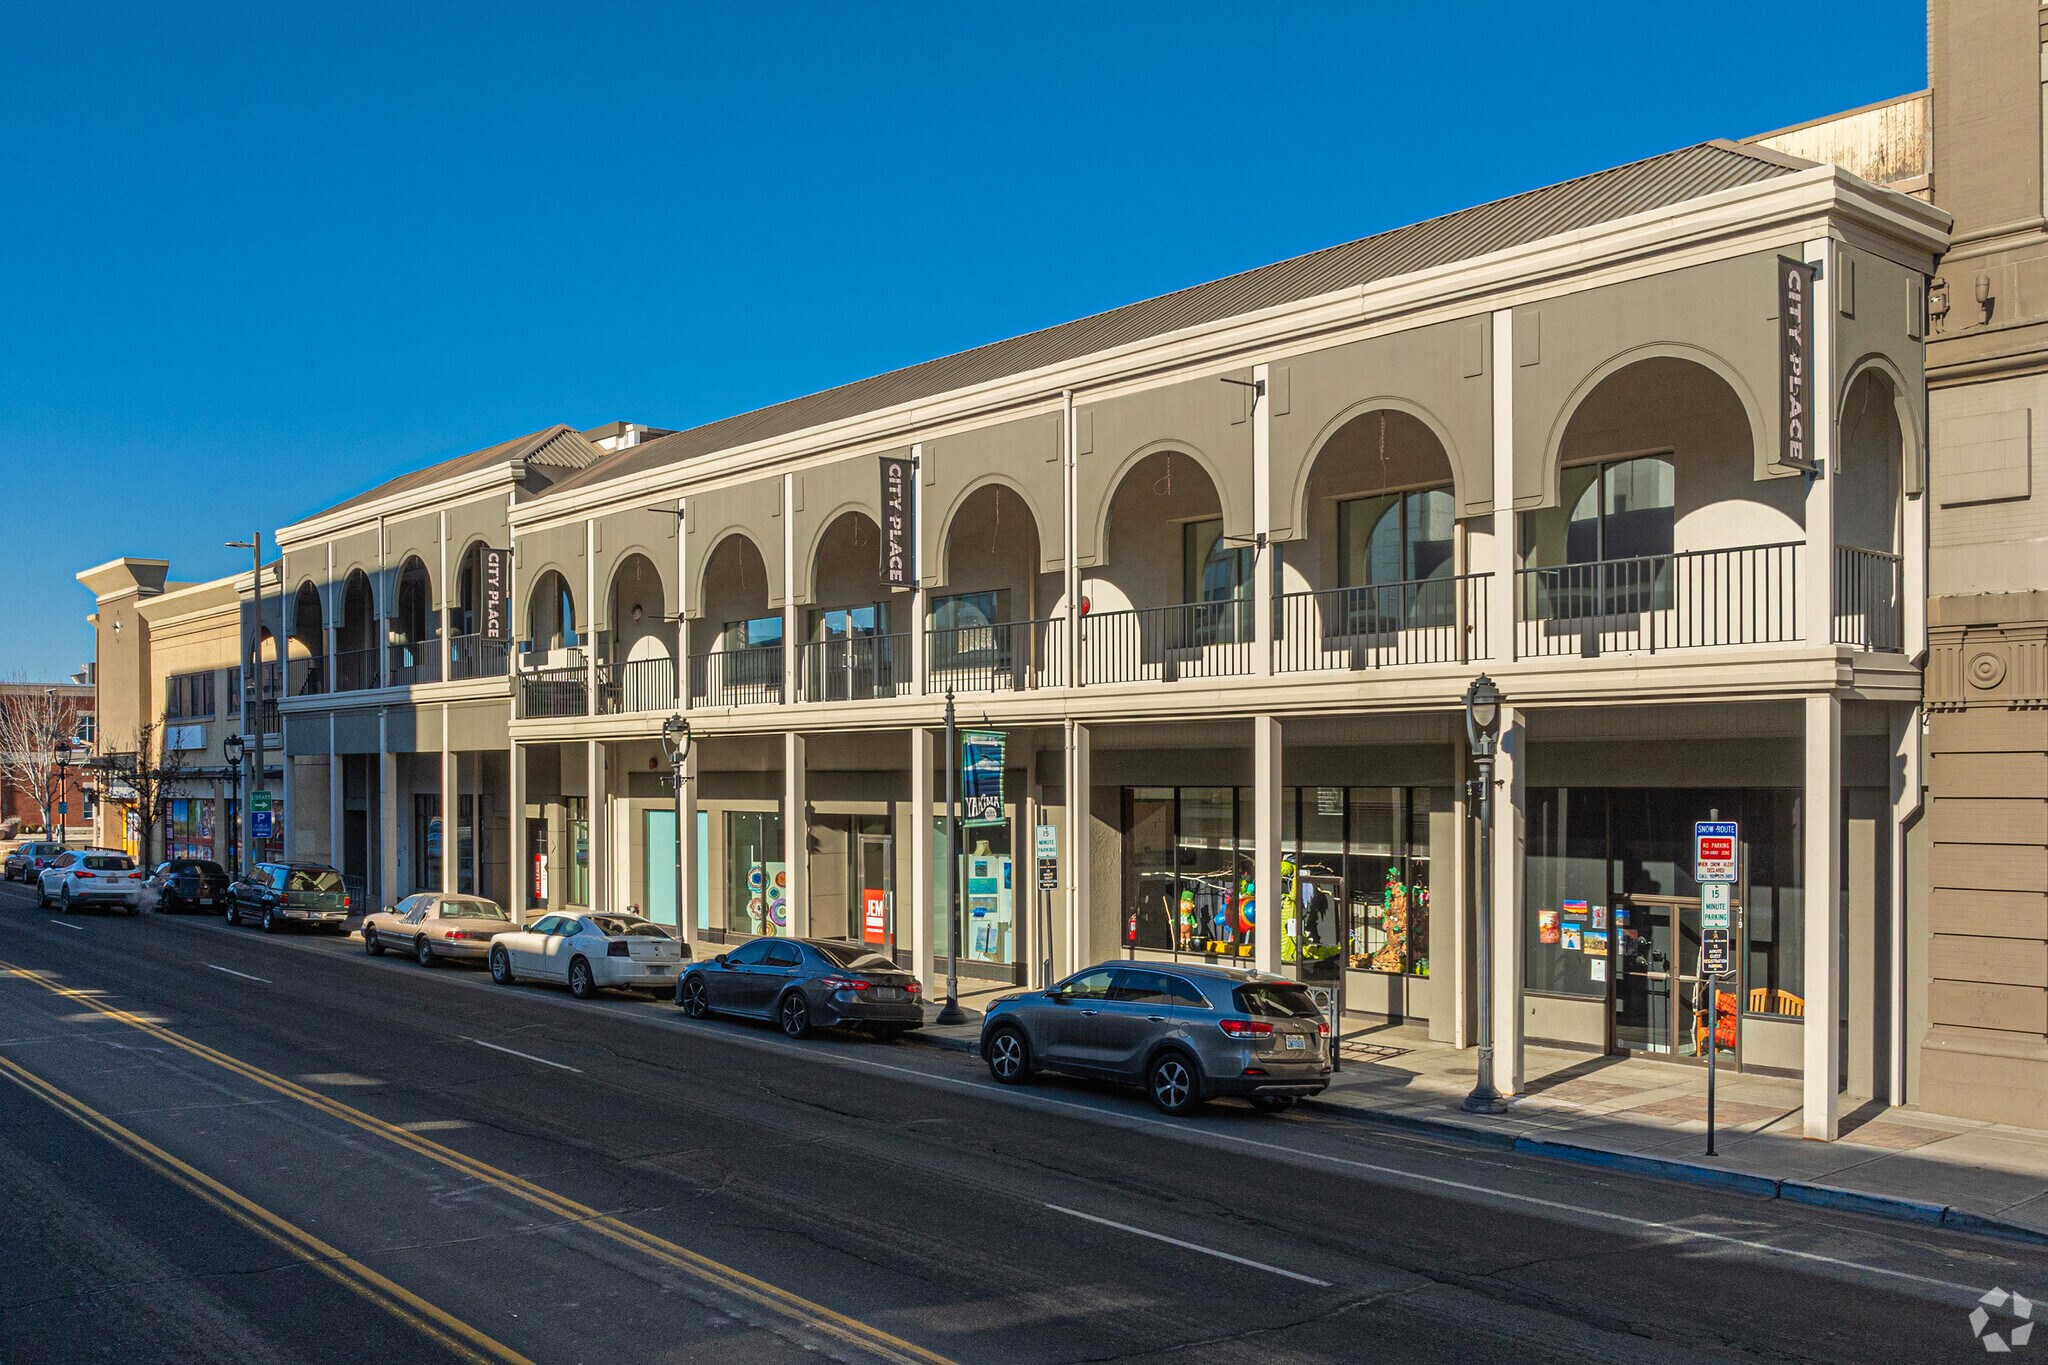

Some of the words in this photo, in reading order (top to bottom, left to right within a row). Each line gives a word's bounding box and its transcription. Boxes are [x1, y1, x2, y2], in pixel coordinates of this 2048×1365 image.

[1788, 269, 1802, 346] CITY
[1789, 353, 1803, 460] PLACE
[888, 463, 901, 511] CITY
[889, 516, 903, 581] PLACE
[488, 552, 499, 587] CITY
[488, 591, 499, 638] PLACE
[258, 814, 265, 822] P
[965, 794, 1000, 817] YAKIMA
[1697, 825, 1714, 833] SNOW
[1717, 825, 1735, 833] ROUTE
[866, 899, 884, 917] JEM
[1711, 889, 1720, 899] 15
